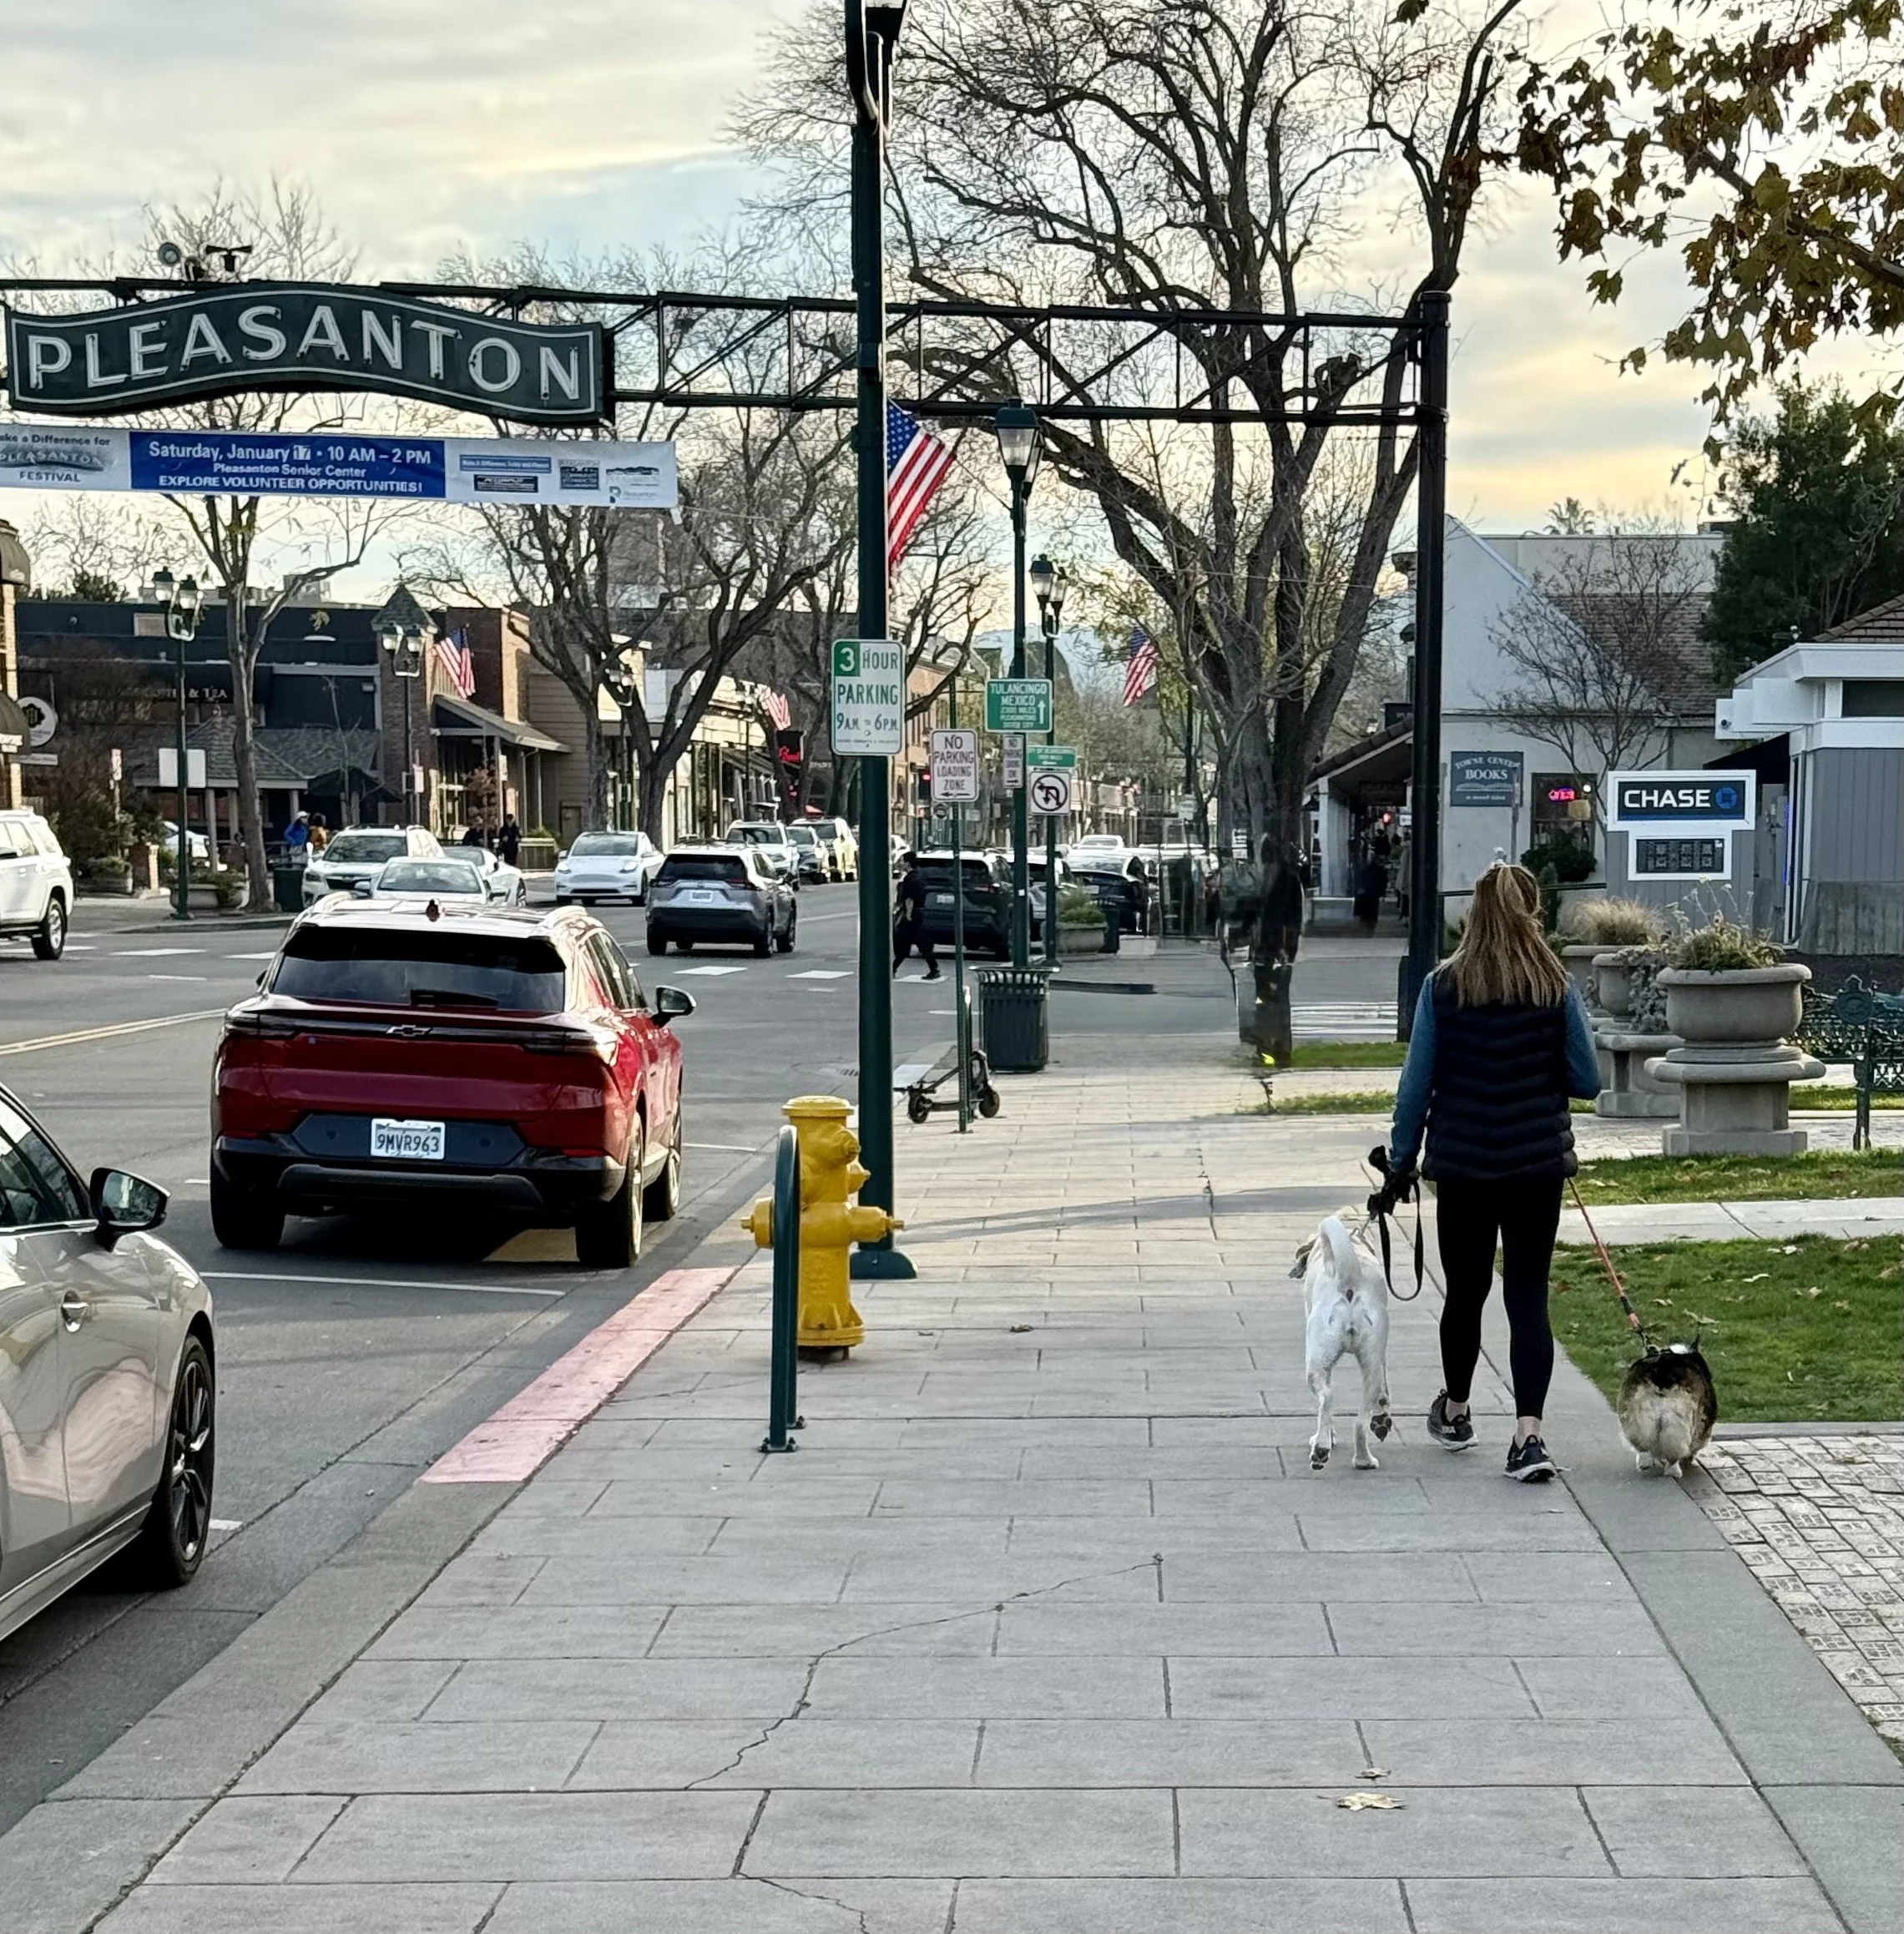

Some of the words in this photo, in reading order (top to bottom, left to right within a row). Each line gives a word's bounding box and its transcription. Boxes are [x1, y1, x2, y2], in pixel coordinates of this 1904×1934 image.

[28, 306, 579, 400] PLEASANTON
[0, 433, 18, 442] ake
[32, 434, 90, 445] Difference
[94, 437, 110, 446] for
[149, 442, 223, 462] Saturday,
[227, 444, 290, 462] January
[327, 446, 344, 462] 10
[348, 448, 376, 462] AM
[391, 448, 402, 463] 2
[406, 450, 431, 464] PM
[20, 471, 81, 482] FESTIVAL
[214, 463, 279, 473] Pleasanton
[281, 463, 321, 476] Senior
[325, 465, 366, 477] Center
[159, 476, 220, 487] EXPLORE
[222, 477, 305, 489] VOLUNTEER
[308, 479, 422, 492] OPPORTUNITIES!
[839, 647, 855, 672] 3
[862, 652, 898, 669] HOUR
[837, 684, 898, 705] PARKING
[1001, 694, 1035, 706] MEXICO
[944, 735, 963, 750] NO
[933, 750, 975, 764] PARKING
[937, 766, 972, 777] LOADING
[1465, 770, 1508, 780] BOOKS
[944, 780, 966, 790] ZONE
[1624, 789, 1711, 808] CHASE
[377, 1134, 440, 1154] 9MVR963
